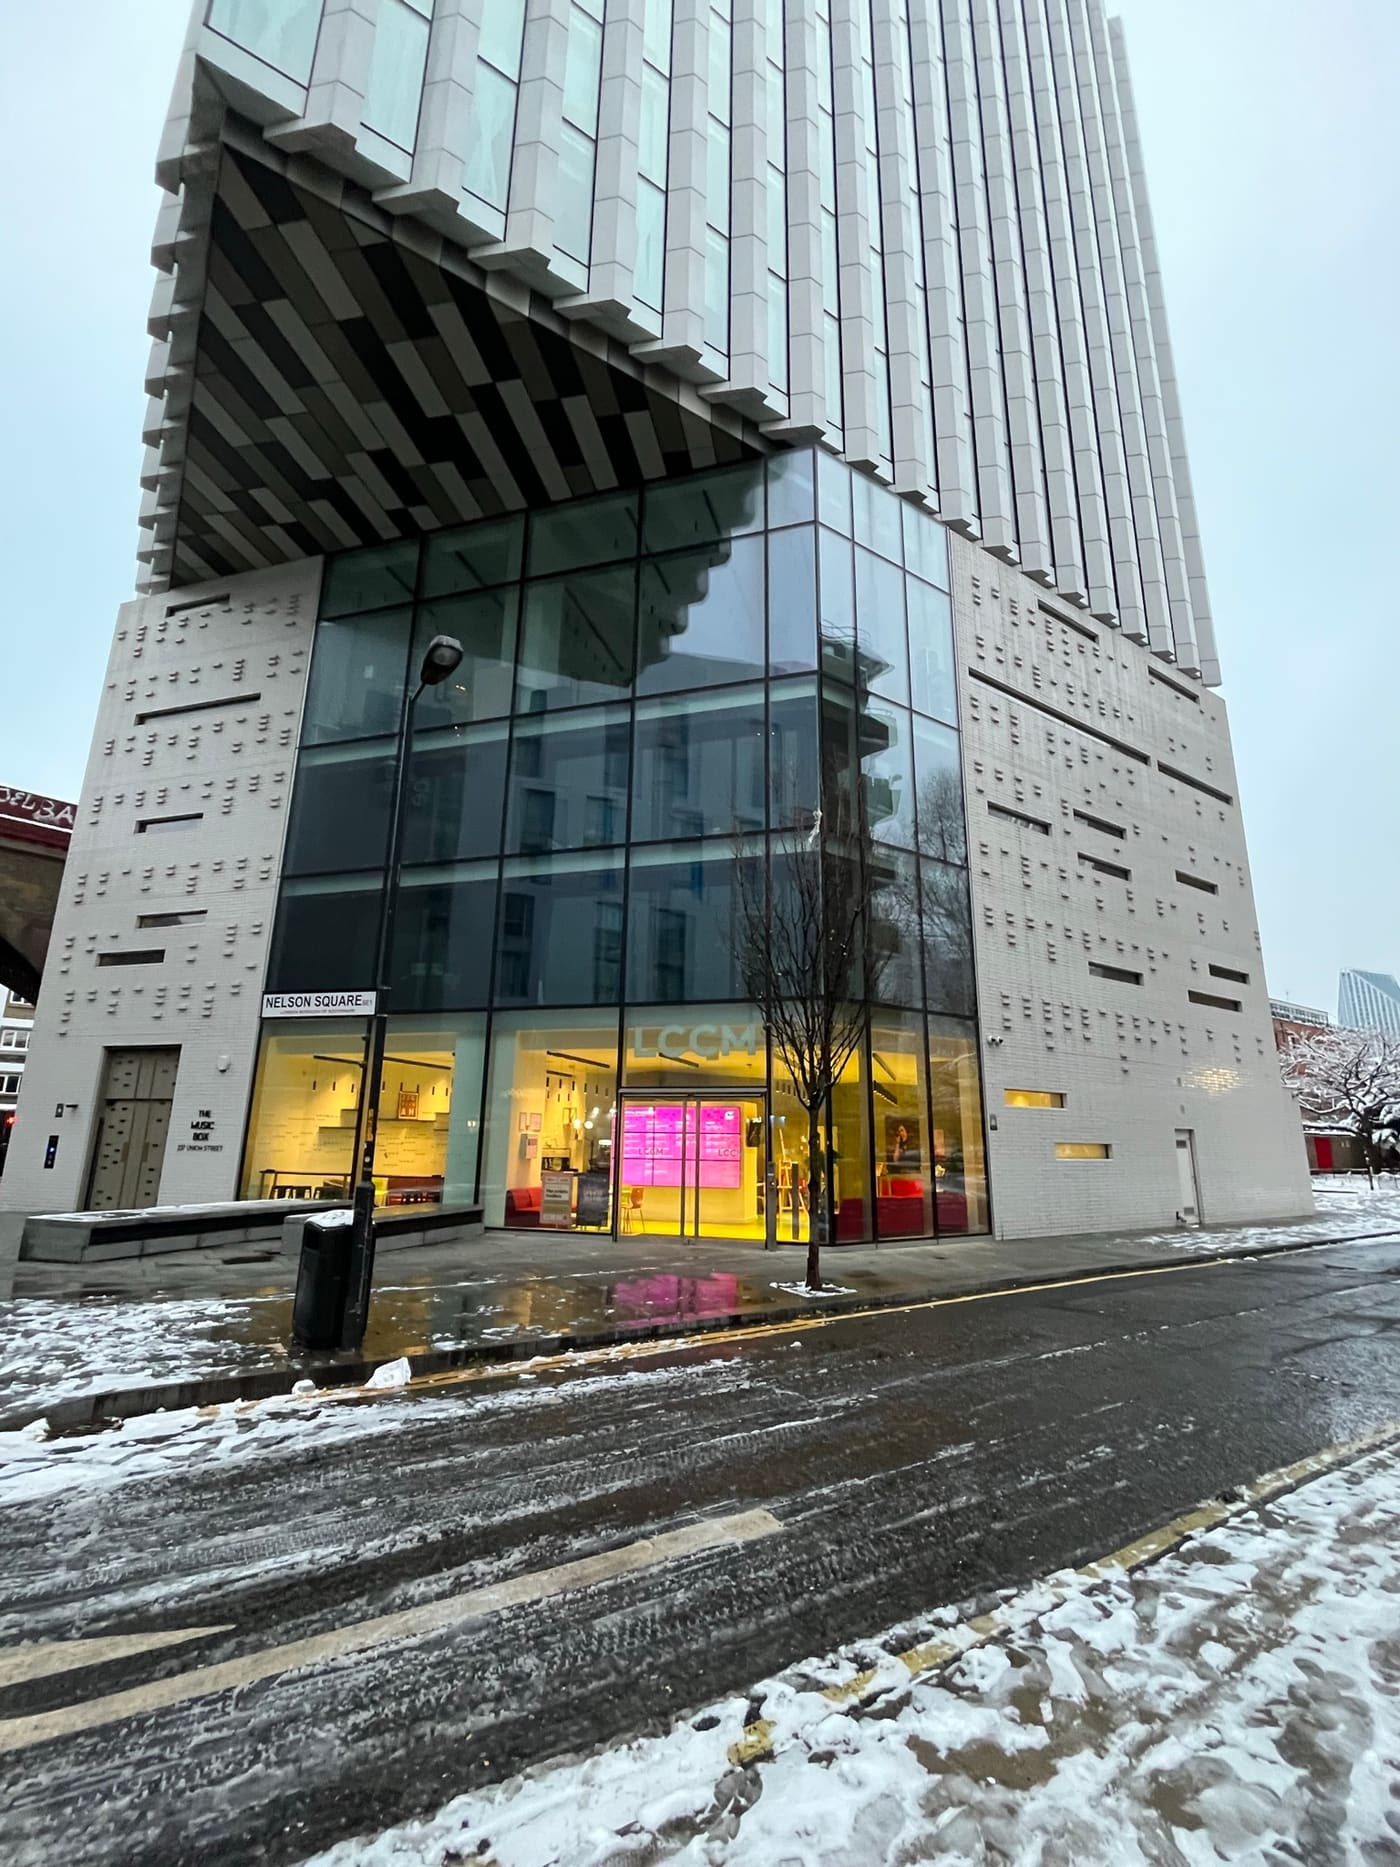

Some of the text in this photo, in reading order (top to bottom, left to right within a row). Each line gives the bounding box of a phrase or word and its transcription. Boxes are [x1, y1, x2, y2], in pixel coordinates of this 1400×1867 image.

[266, 996, 311, 1008] NELSON
[314, 994, 362, 1007] SQUARE
[634, 1024, 756, 1059] LCCM
[198, 1110, 211, 1118] THE
[191, 1121, 215, 1130] MUSIC
[192, 1132, 209, 1141] BOX
